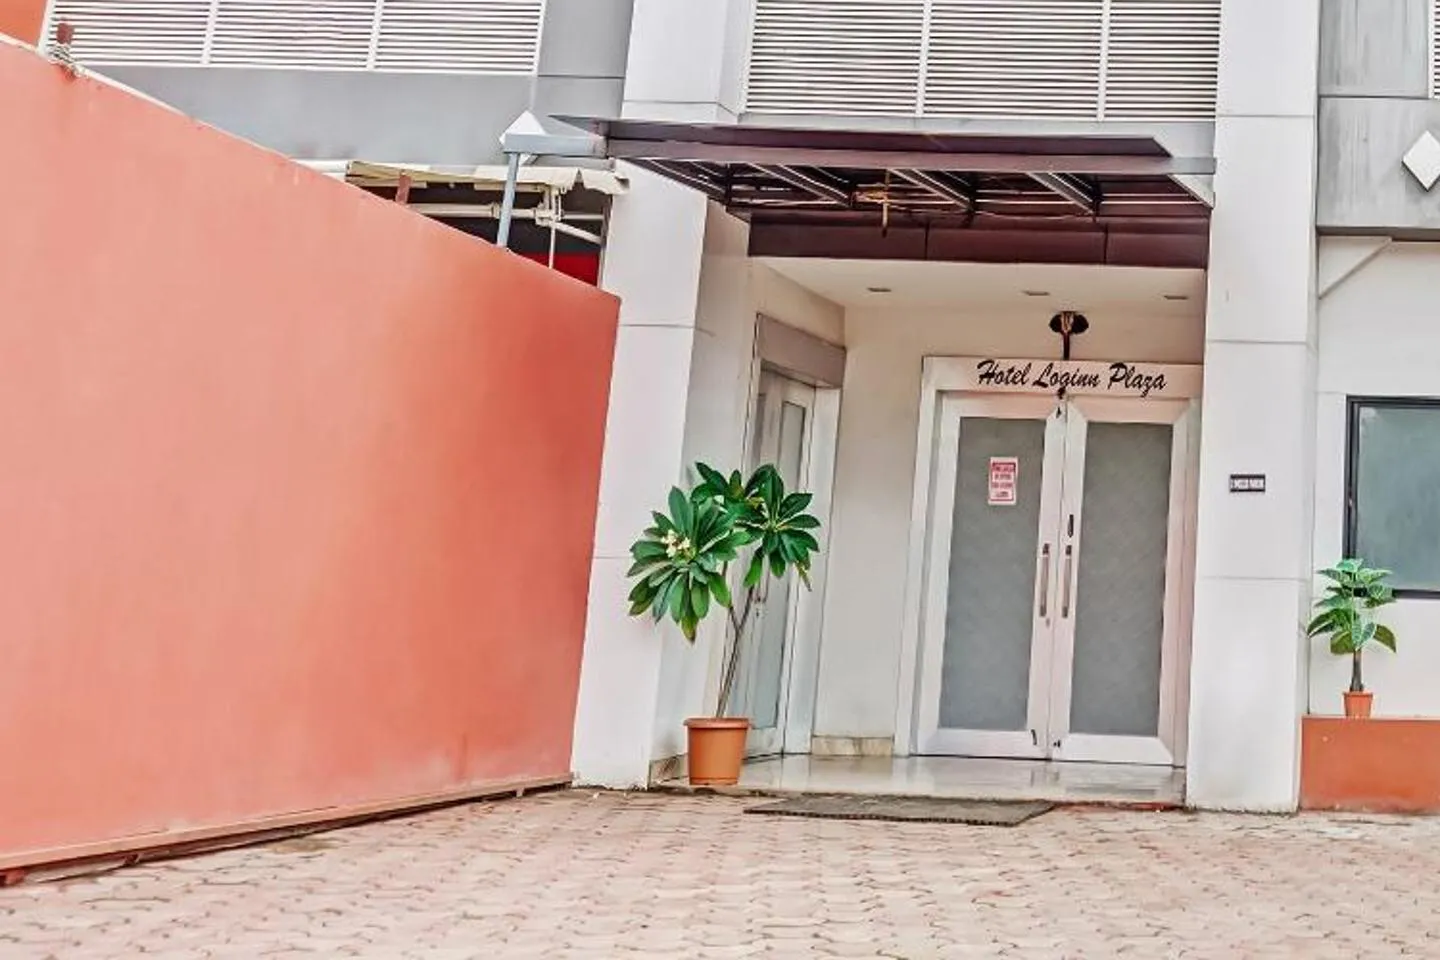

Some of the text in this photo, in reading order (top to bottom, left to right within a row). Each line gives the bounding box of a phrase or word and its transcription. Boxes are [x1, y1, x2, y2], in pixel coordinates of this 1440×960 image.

[976, 360, 1167, 398] Hotel Loginn Plaza
